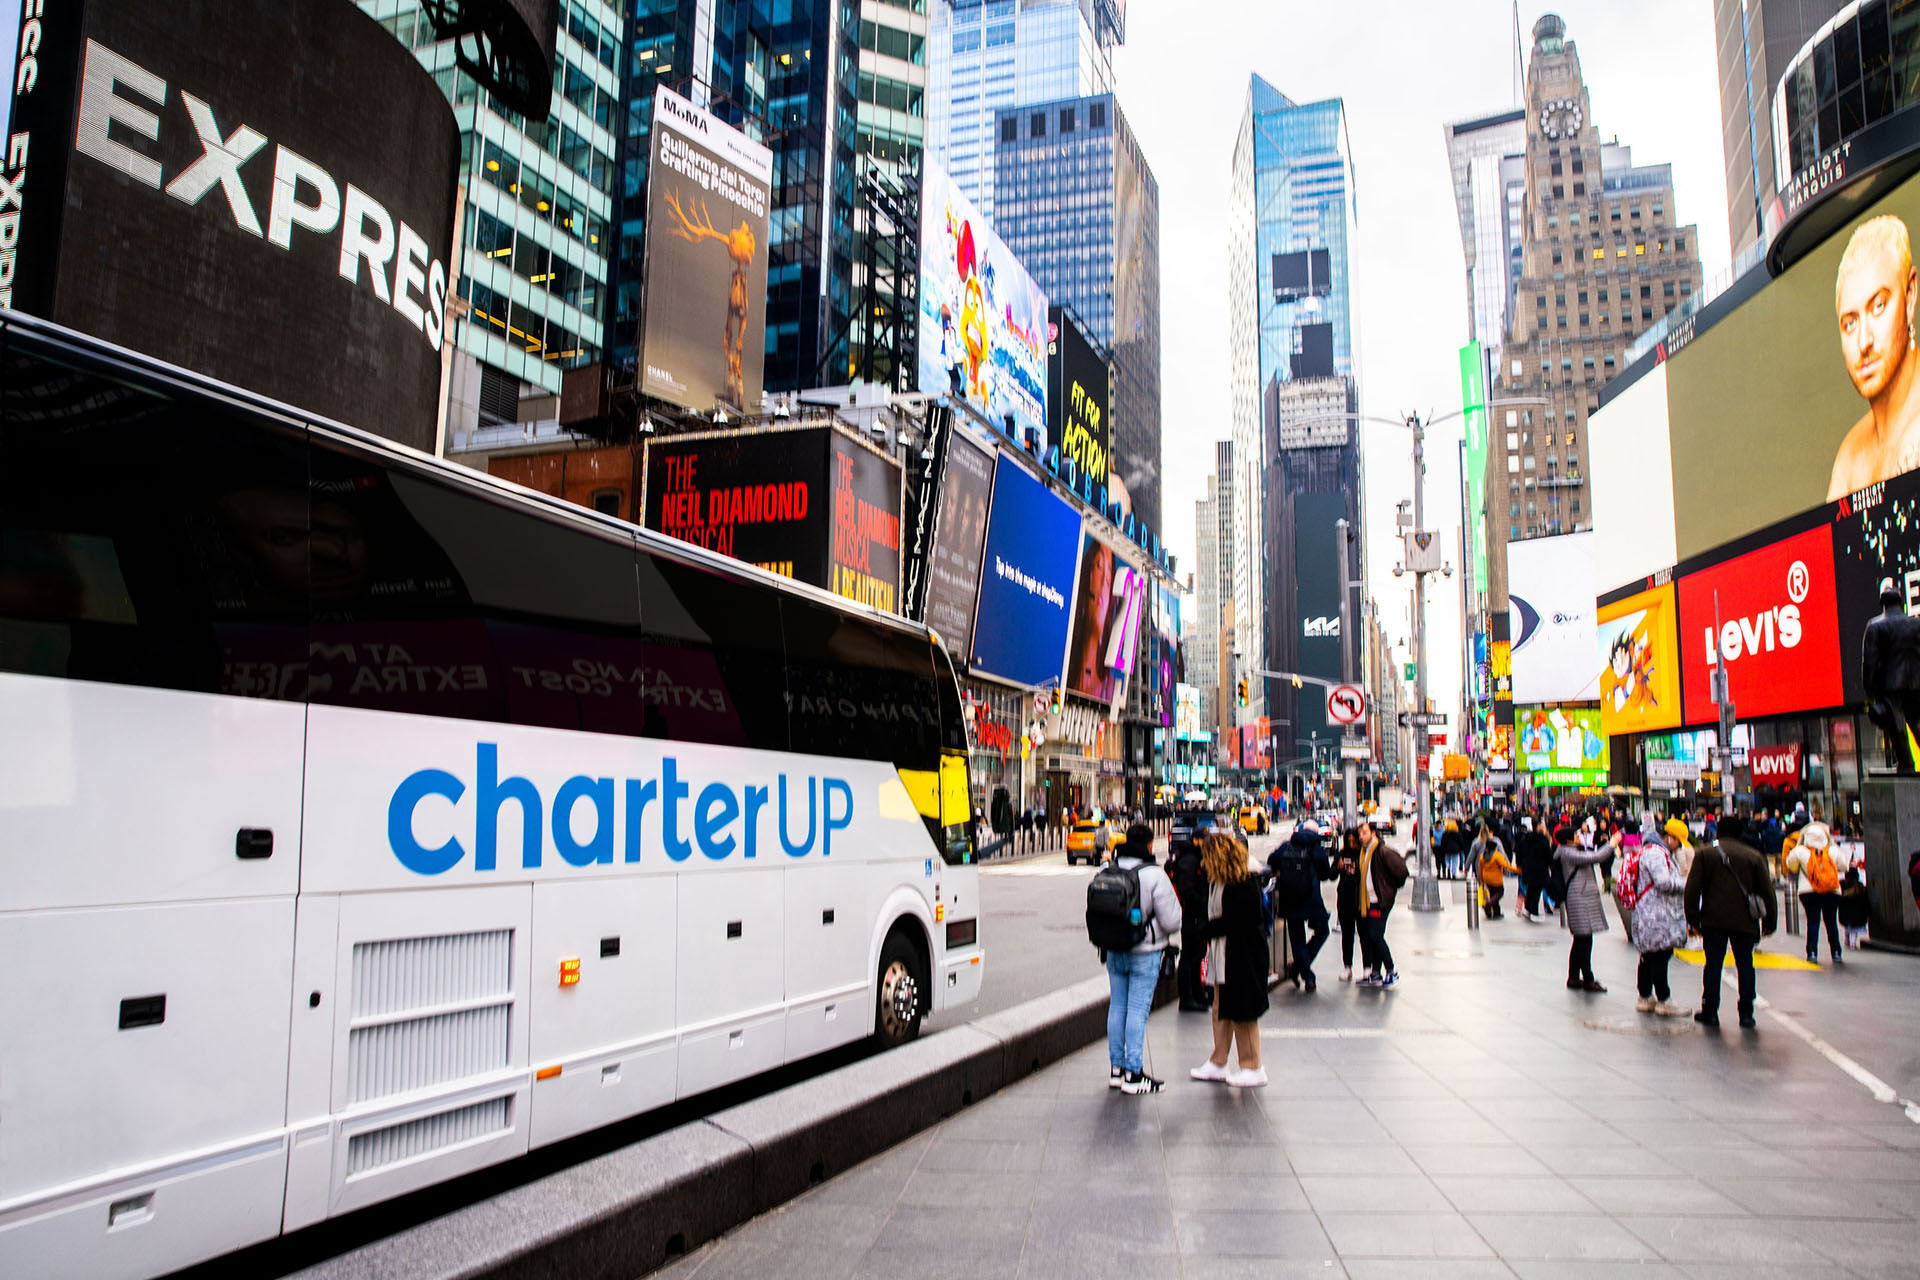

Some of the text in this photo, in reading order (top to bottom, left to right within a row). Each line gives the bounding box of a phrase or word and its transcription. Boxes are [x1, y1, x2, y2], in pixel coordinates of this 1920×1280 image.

[663, 97, 708, 134] MoMA
[660, 147, 710, 190] Crafting
[711, 174, 764, 218] Pinocchio
[661, 131, 719, 176] Guillermo
[720, 165, 737, 188] del
[1788, 141, 1851, 198] MARRIOTT
[1789, 163, 1843, 213] MARQUIS
[1071, 380, 1101, 433] FIT FOR
[665, 454, 698, 491] THE
[837, 452, 854, 495] THE
[1063, 415, 1106, 484] ACTION
[662, 481, 808, 529] NEIL DIAMOND
[835, 487, 899, 551] NEIL DIAMOND
[1084, 471, 1176, 575] BROADWA
[662, 525, 738, 560] USICAL
[834, 526, 871, 573] MUSICAL
[842, 567, 893, 612] BEAUTIFUL
[388, 742, 853, 875] charterUP
